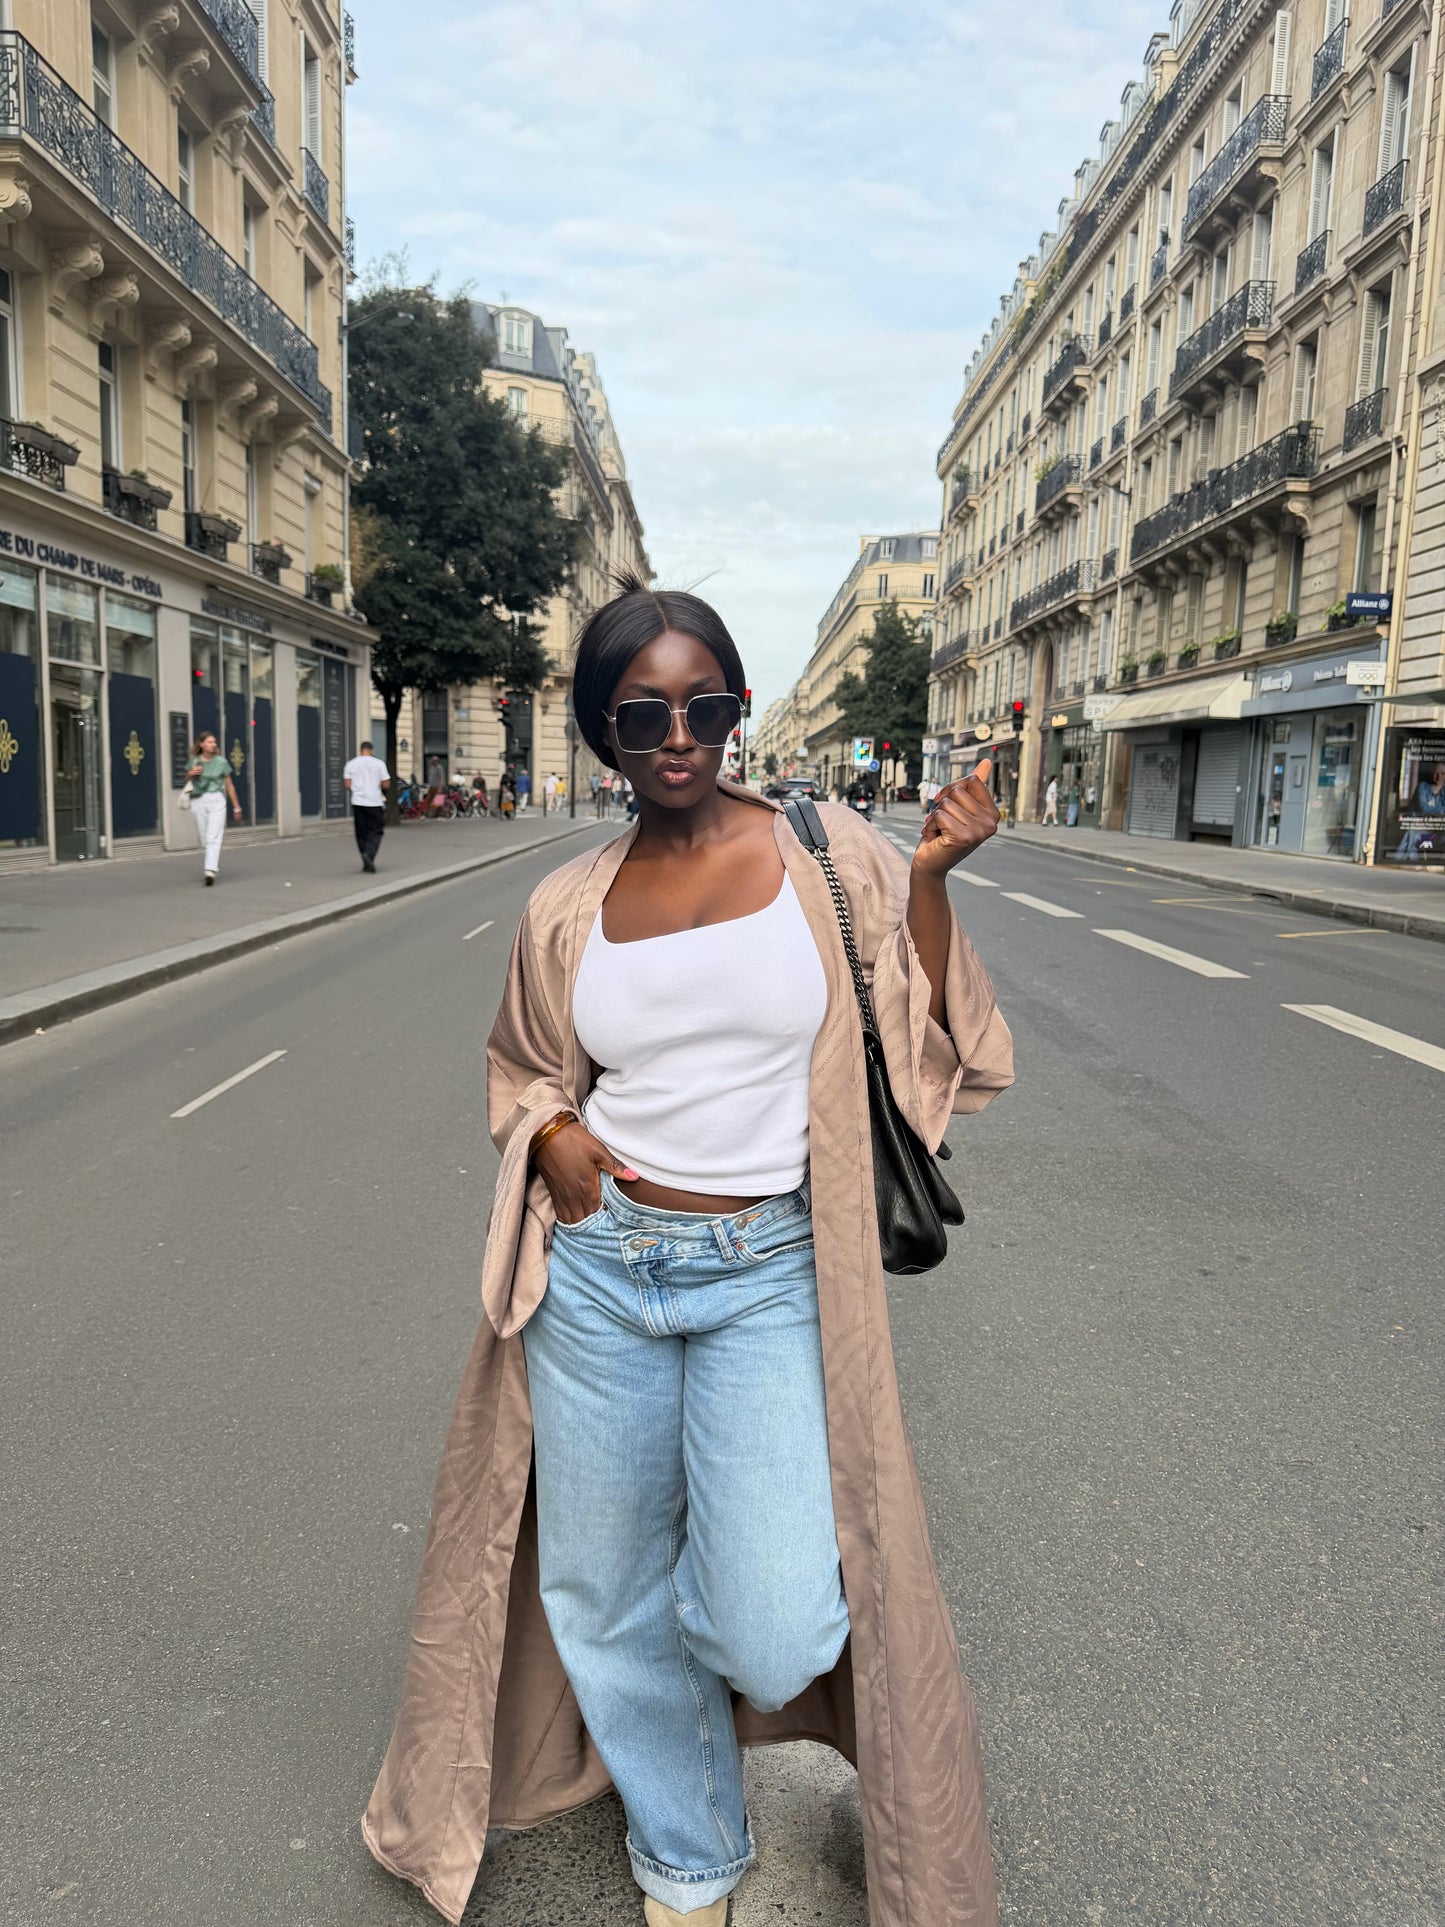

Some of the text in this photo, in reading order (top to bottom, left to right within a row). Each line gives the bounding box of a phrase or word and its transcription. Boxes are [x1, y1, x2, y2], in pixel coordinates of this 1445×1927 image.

[15, 535, 34, 558] DU
[37, 543, 78, 571] CHAMP
[80, 557, 96, 577] DE
[1351, 599, 1378, 608] Allianz
[1419, 840, 1433, 848] AXA
